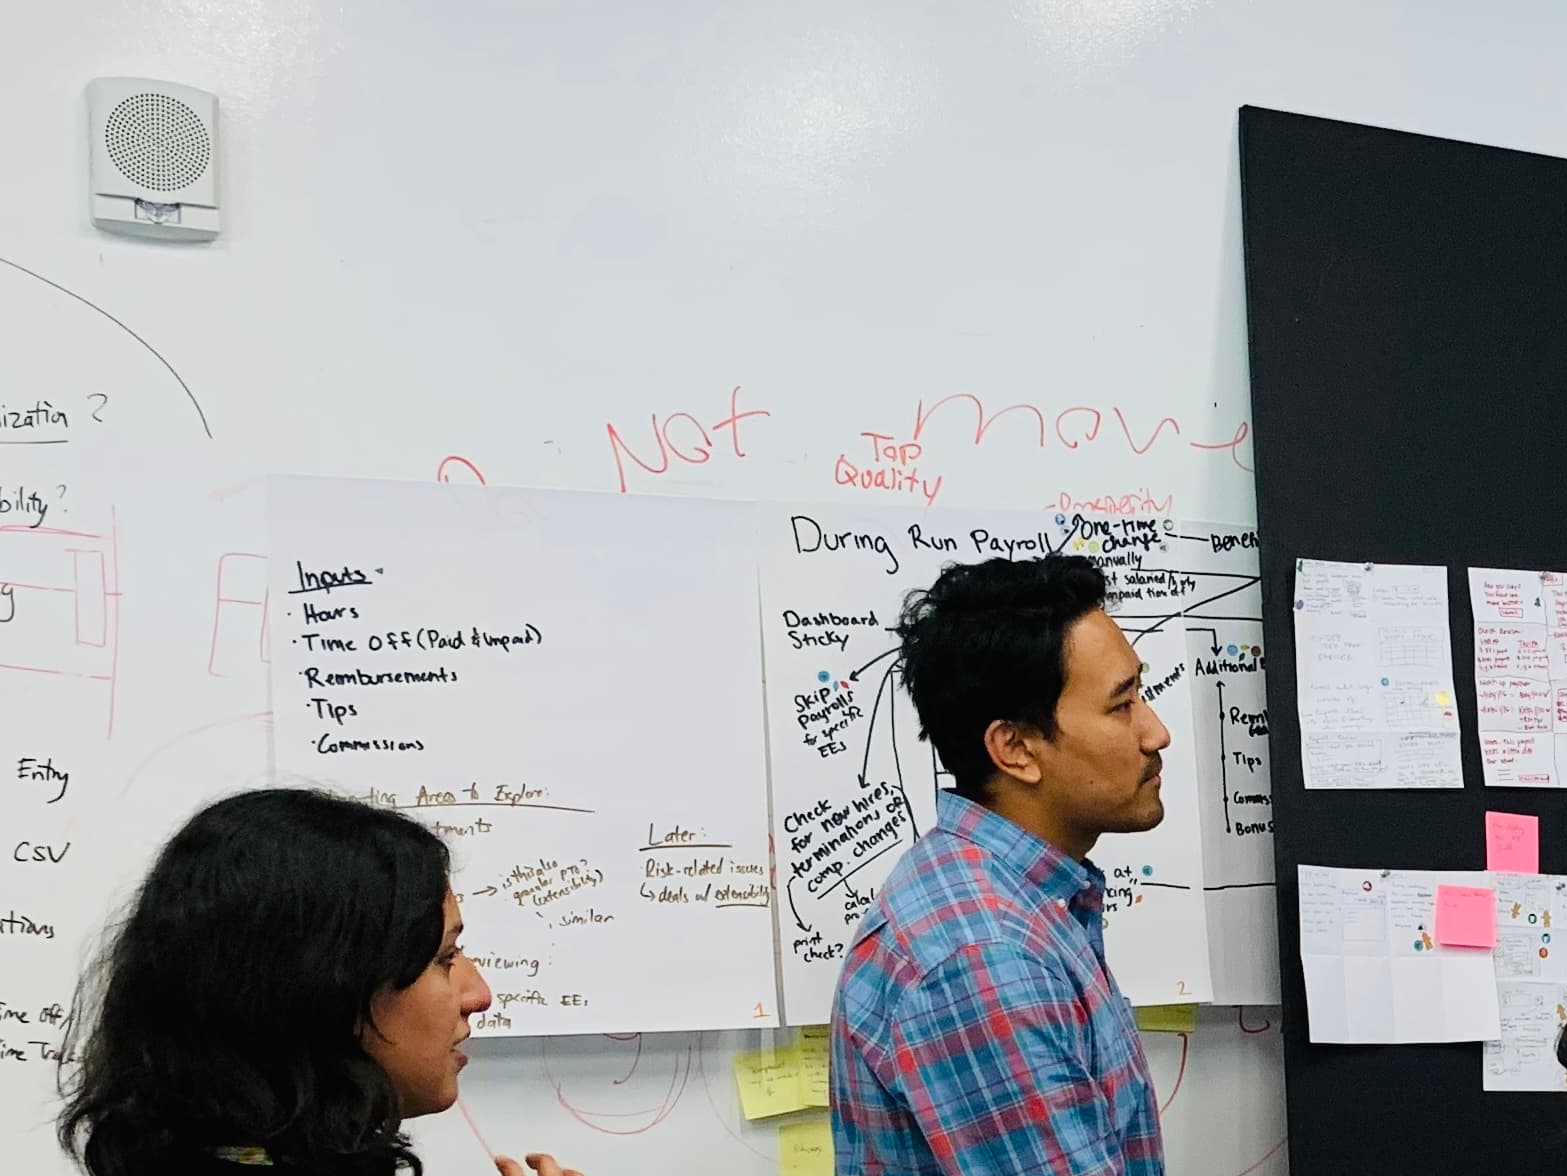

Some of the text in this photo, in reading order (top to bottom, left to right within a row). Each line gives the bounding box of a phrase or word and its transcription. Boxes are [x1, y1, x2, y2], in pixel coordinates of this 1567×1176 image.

[0, 400, 69, 429] ization
[860, 432, 923, 467] Top
[834, 454, 943, 506] Quality
[790, 516, 1053, 575] During Run Payroll
[1102, 531, 1162, 553] change
[303, 602, 360, 625] Hours
[782, 609, 880, 629] Dashboard
[301, 633, 358, 651] Time
[787, 630, 850, 652] Sticky
[1194, 657, 1258, 677] Additional
[310, 698, 359, 726] Tips
[317, 733, 425, 754] Commissions
[1232, 751, 1263, 774] Tips
[17, 760, 69, 803] Entry
[784, 799, 833, 833] Check
[790, 831, 813, 854] for
[851, 781, 895, 813] hires,
[852, 810, 907, 858] changes
[14, 841, 71, 863] CSV
[645, 856, 765, 878] Risk-related issues
[658, 885, 689, 904] deals
[559, 907, 616, 927] similar
[793, 931, 823, 954] print
[803, 943, 845, 963] check?
[0, 1002, 30, 1024] ime
[476, 1012, 513, 1030] data
[0, 1039, 27, 1061] ime
